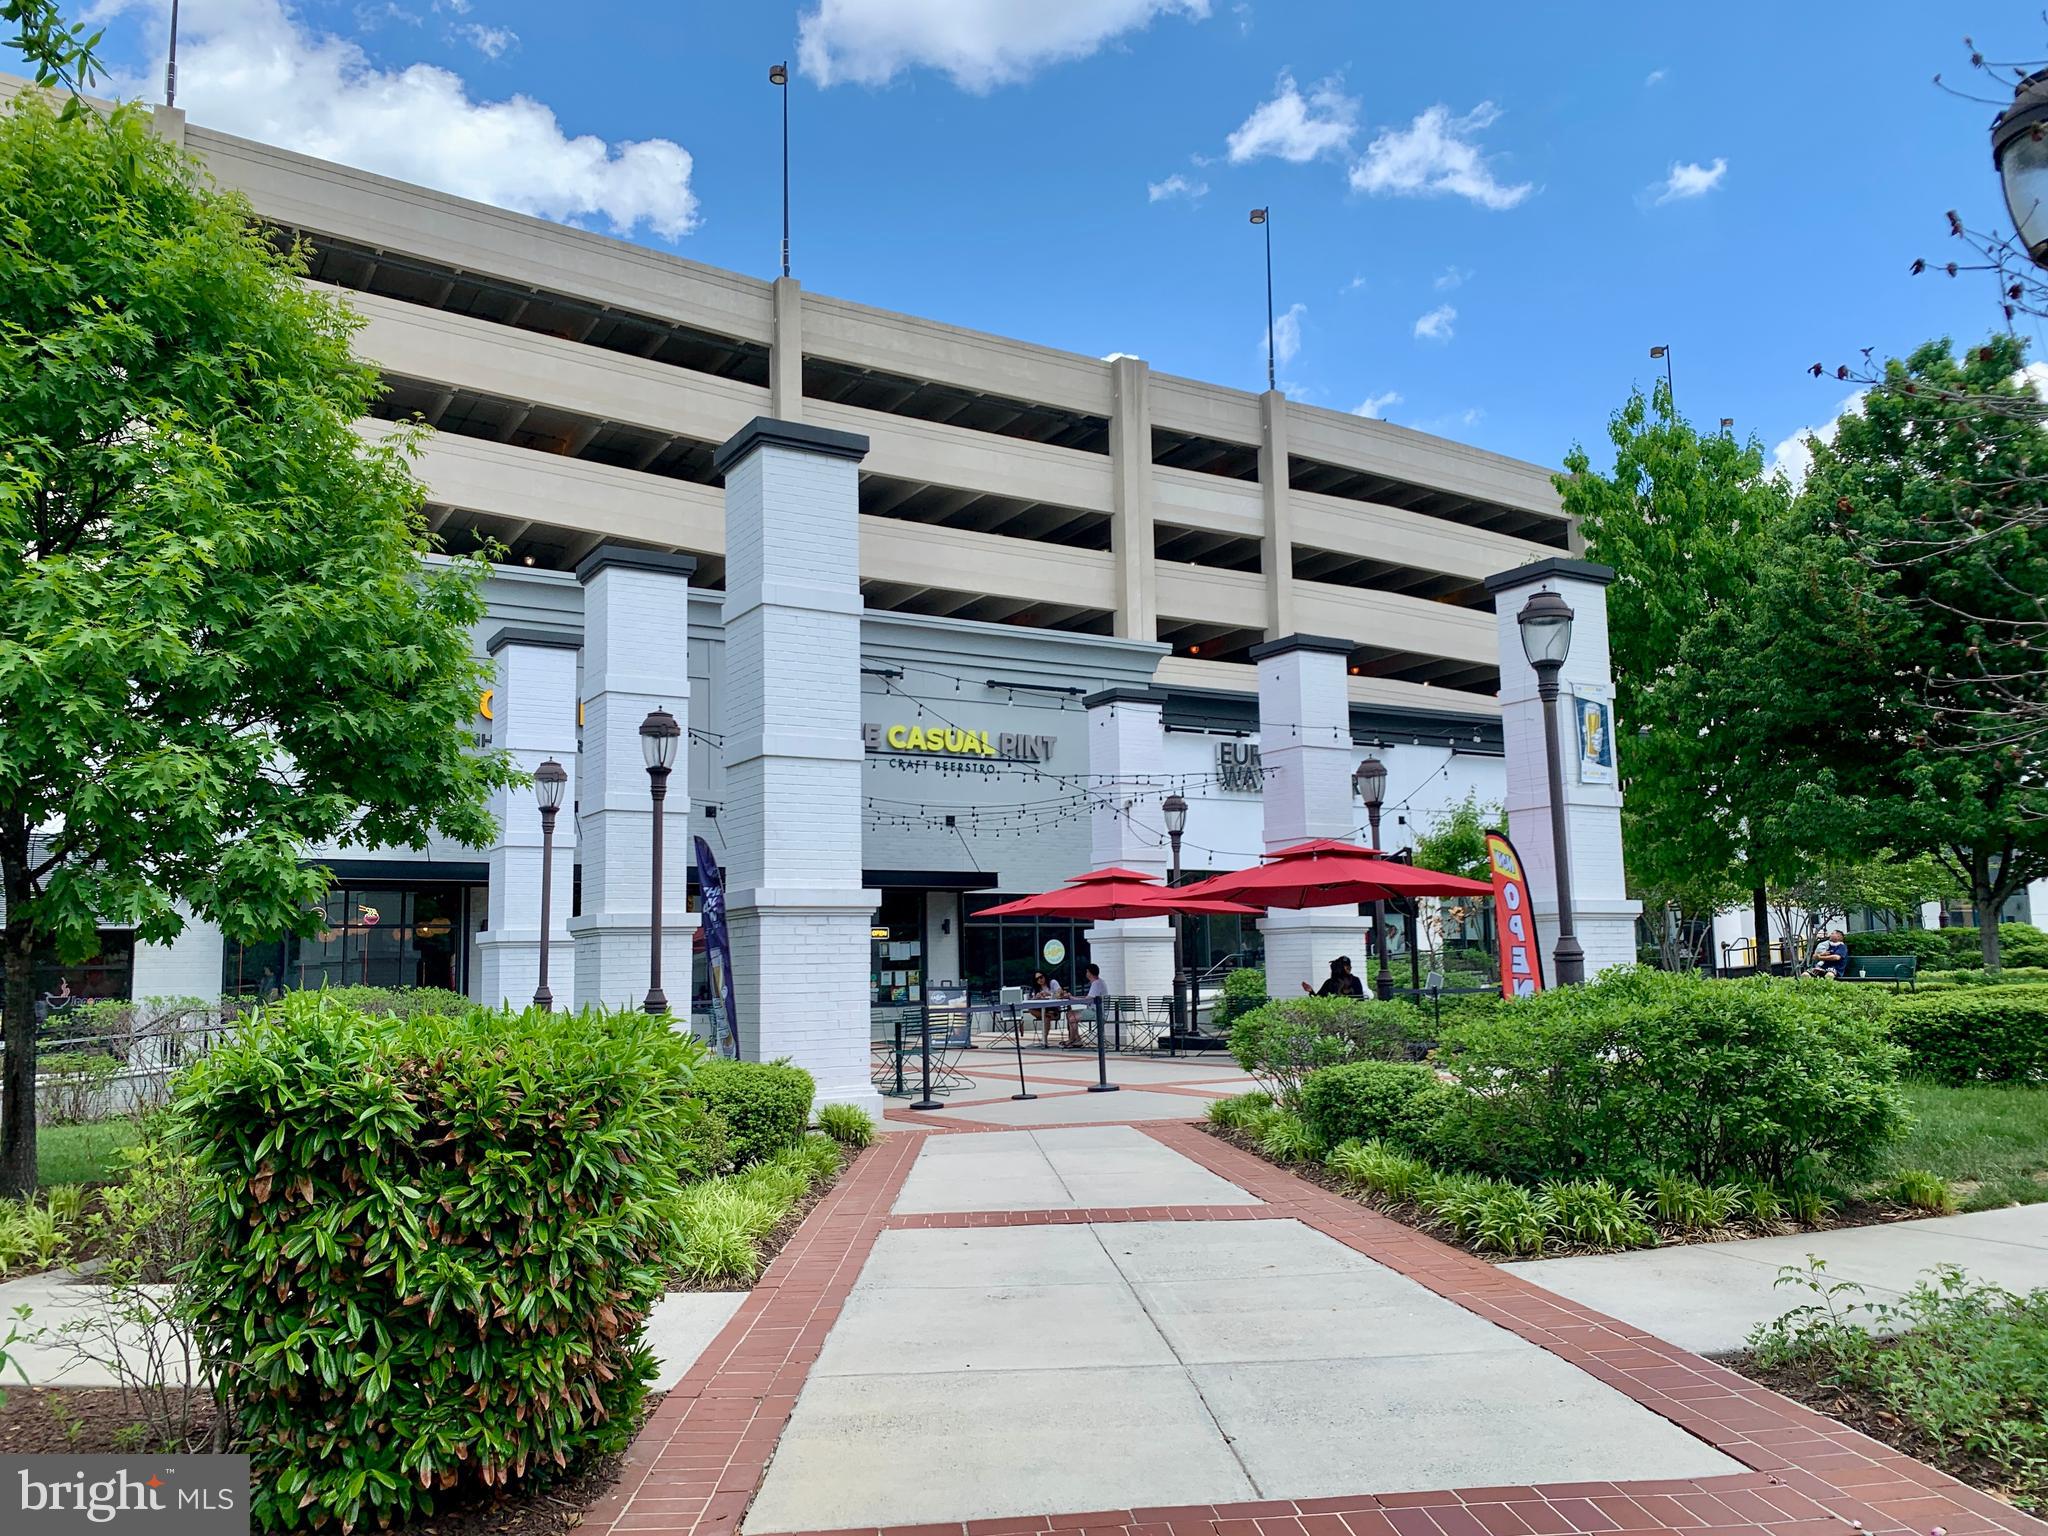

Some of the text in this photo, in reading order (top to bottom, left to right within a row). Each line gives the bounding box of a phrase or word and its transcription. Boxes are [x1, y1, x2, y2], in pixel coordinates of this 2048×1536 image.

[887, 725, 996, 755] CASUAL
[1000, 732, 1057, 759] PINT
[889, 758, 996, 774] CRAFT BEERSTRO
